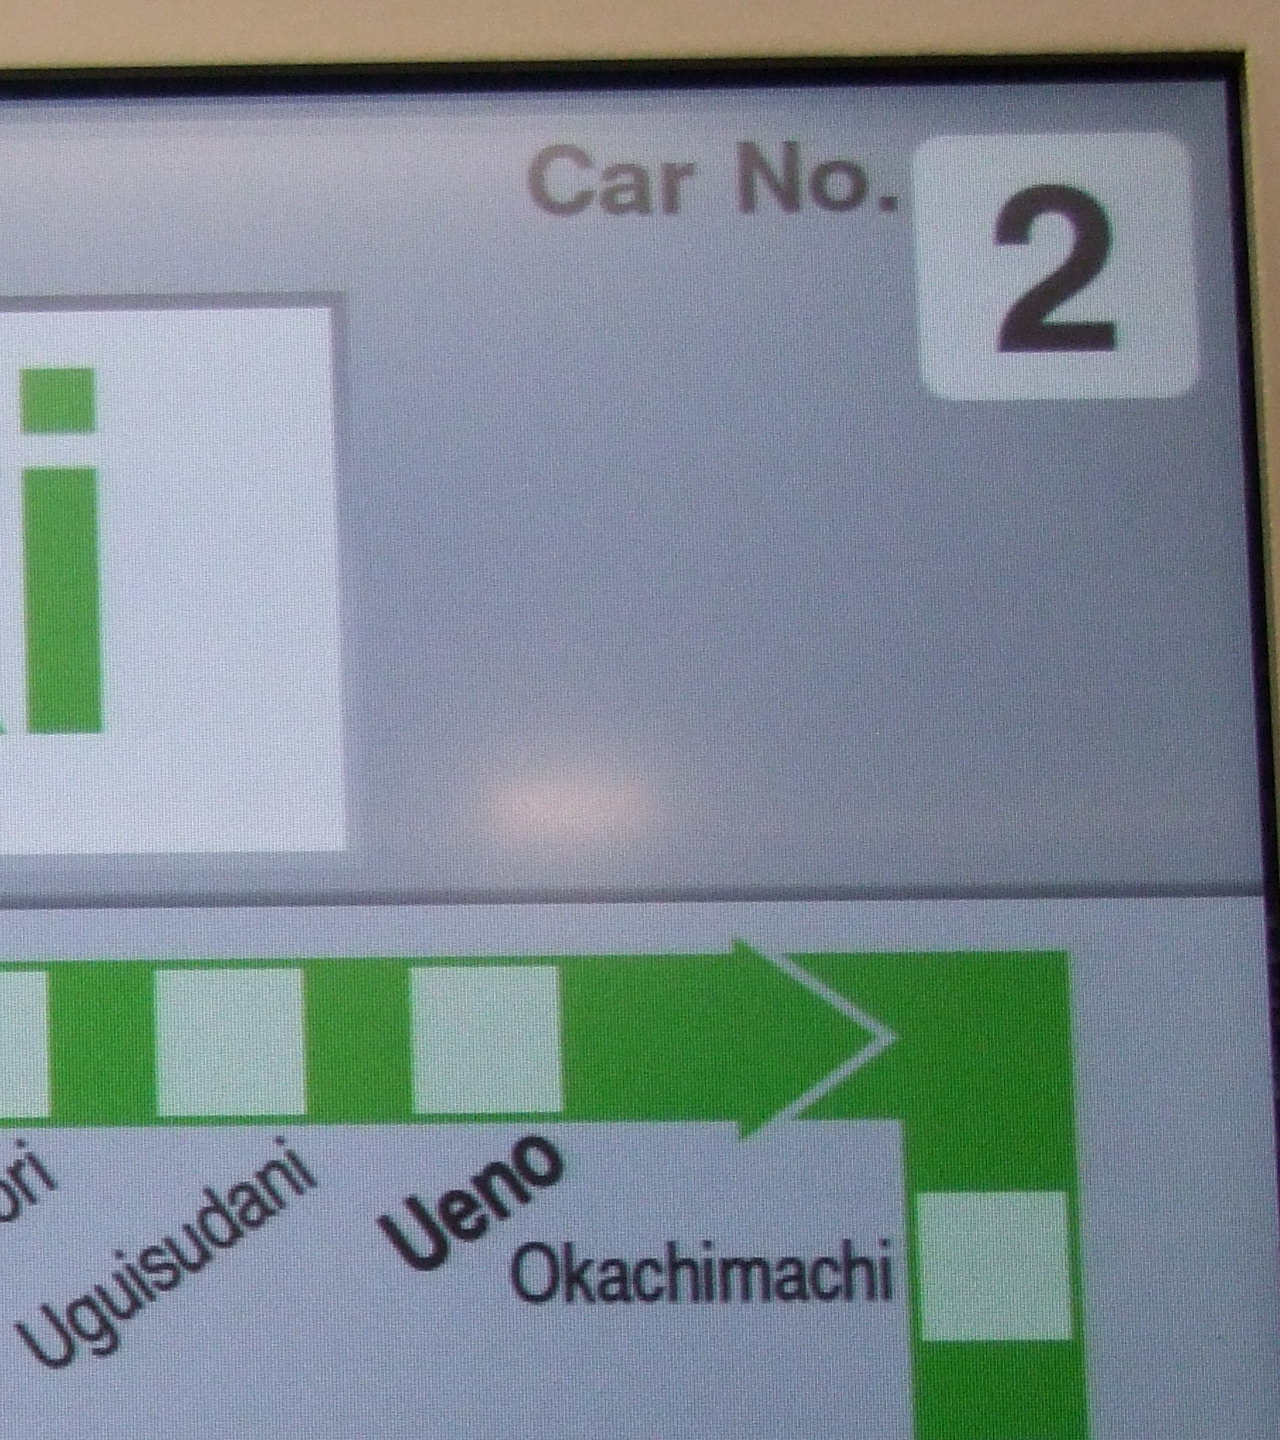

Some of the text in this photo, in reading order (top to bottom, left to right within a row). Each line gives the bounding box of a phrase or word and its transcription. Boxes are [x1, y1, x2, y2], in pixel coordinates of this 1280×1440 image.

[528, 140, 1116, 353] Car No. 2
[15, 1134, 321, 1375] Uguisudani
[376, 1134, 565, 1273] Ueno
[510, 1240, 893, 1306] Okachimachi
